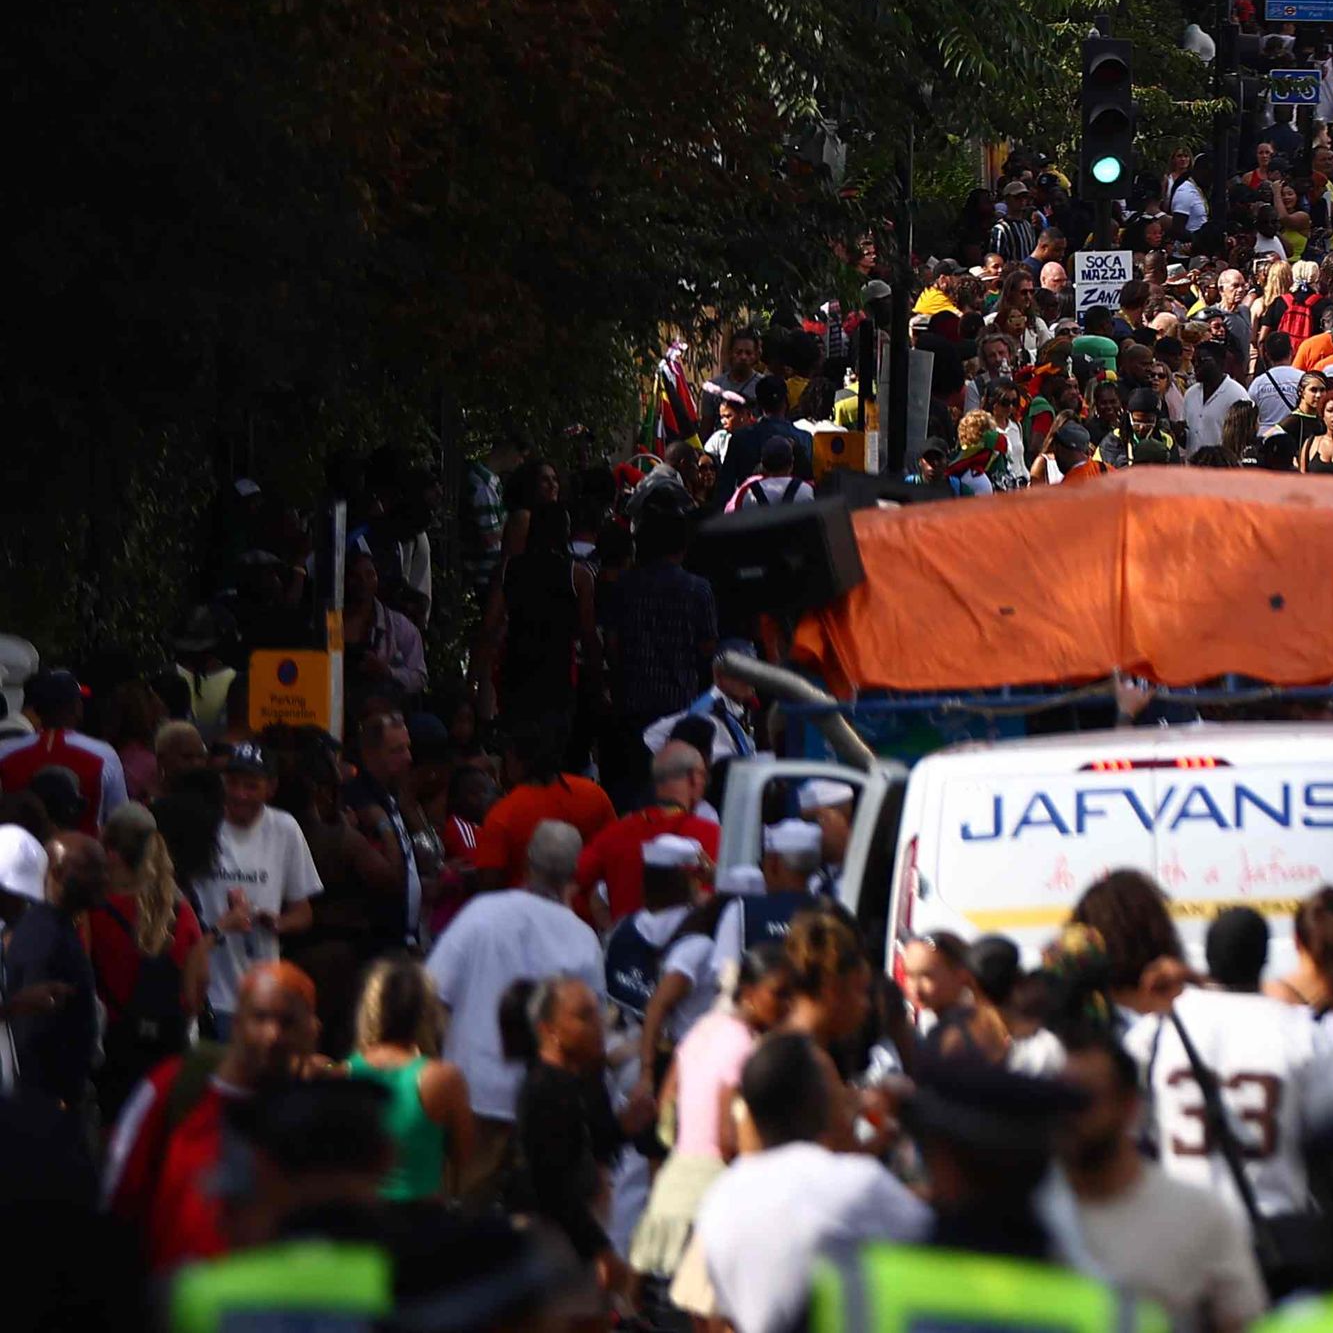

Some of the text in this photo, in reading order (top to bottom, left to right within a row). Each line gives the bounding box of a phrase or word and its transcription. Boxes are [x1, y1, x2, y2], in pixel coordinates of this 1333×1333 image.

[1086, 255, 1122, 269] SOCA
[1081, 268, 1127, 281] MAZZA
[270, 694, 307, 707] Parking
[1167, 1067, 1282, 1160] 33
